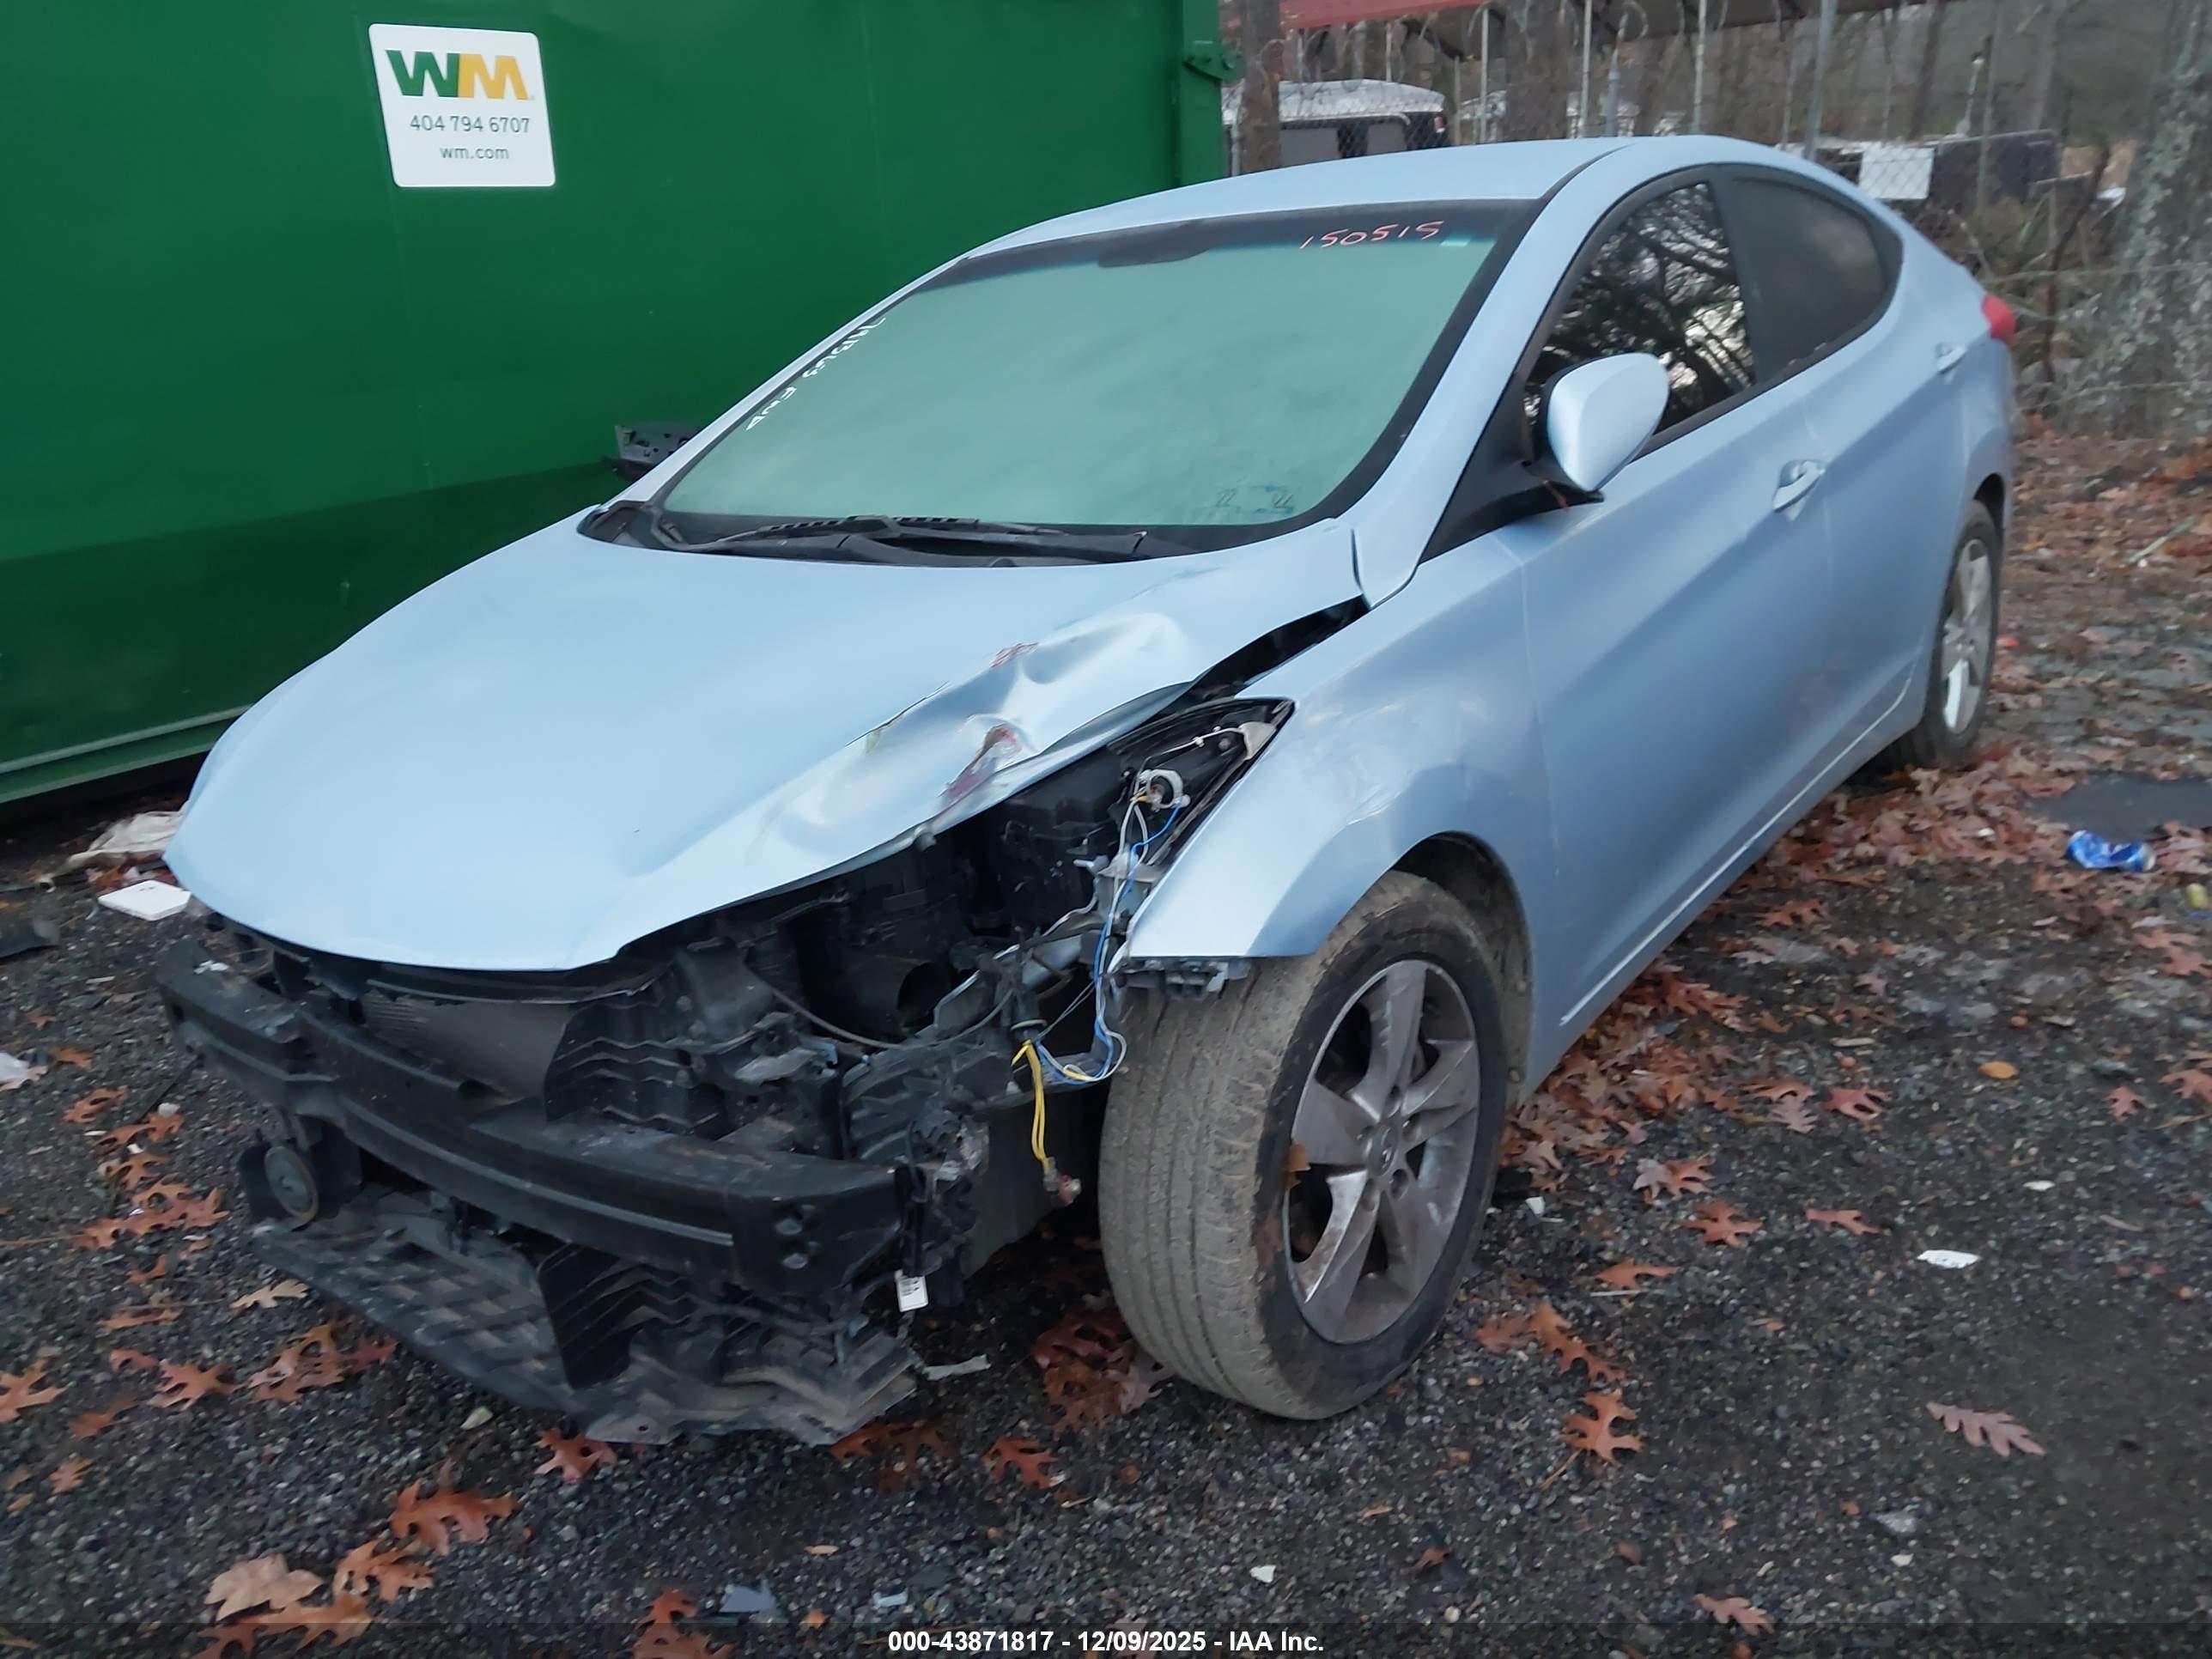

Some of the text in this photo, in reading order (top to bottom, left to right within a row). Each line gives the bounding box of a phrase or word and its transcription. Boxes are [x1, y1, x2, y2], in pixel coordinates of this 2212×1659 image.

[386, 49, 530, 100] WM
[410, 114, 530, 133] 404 794 6707
[439, 146, 509, 160] wm.com
